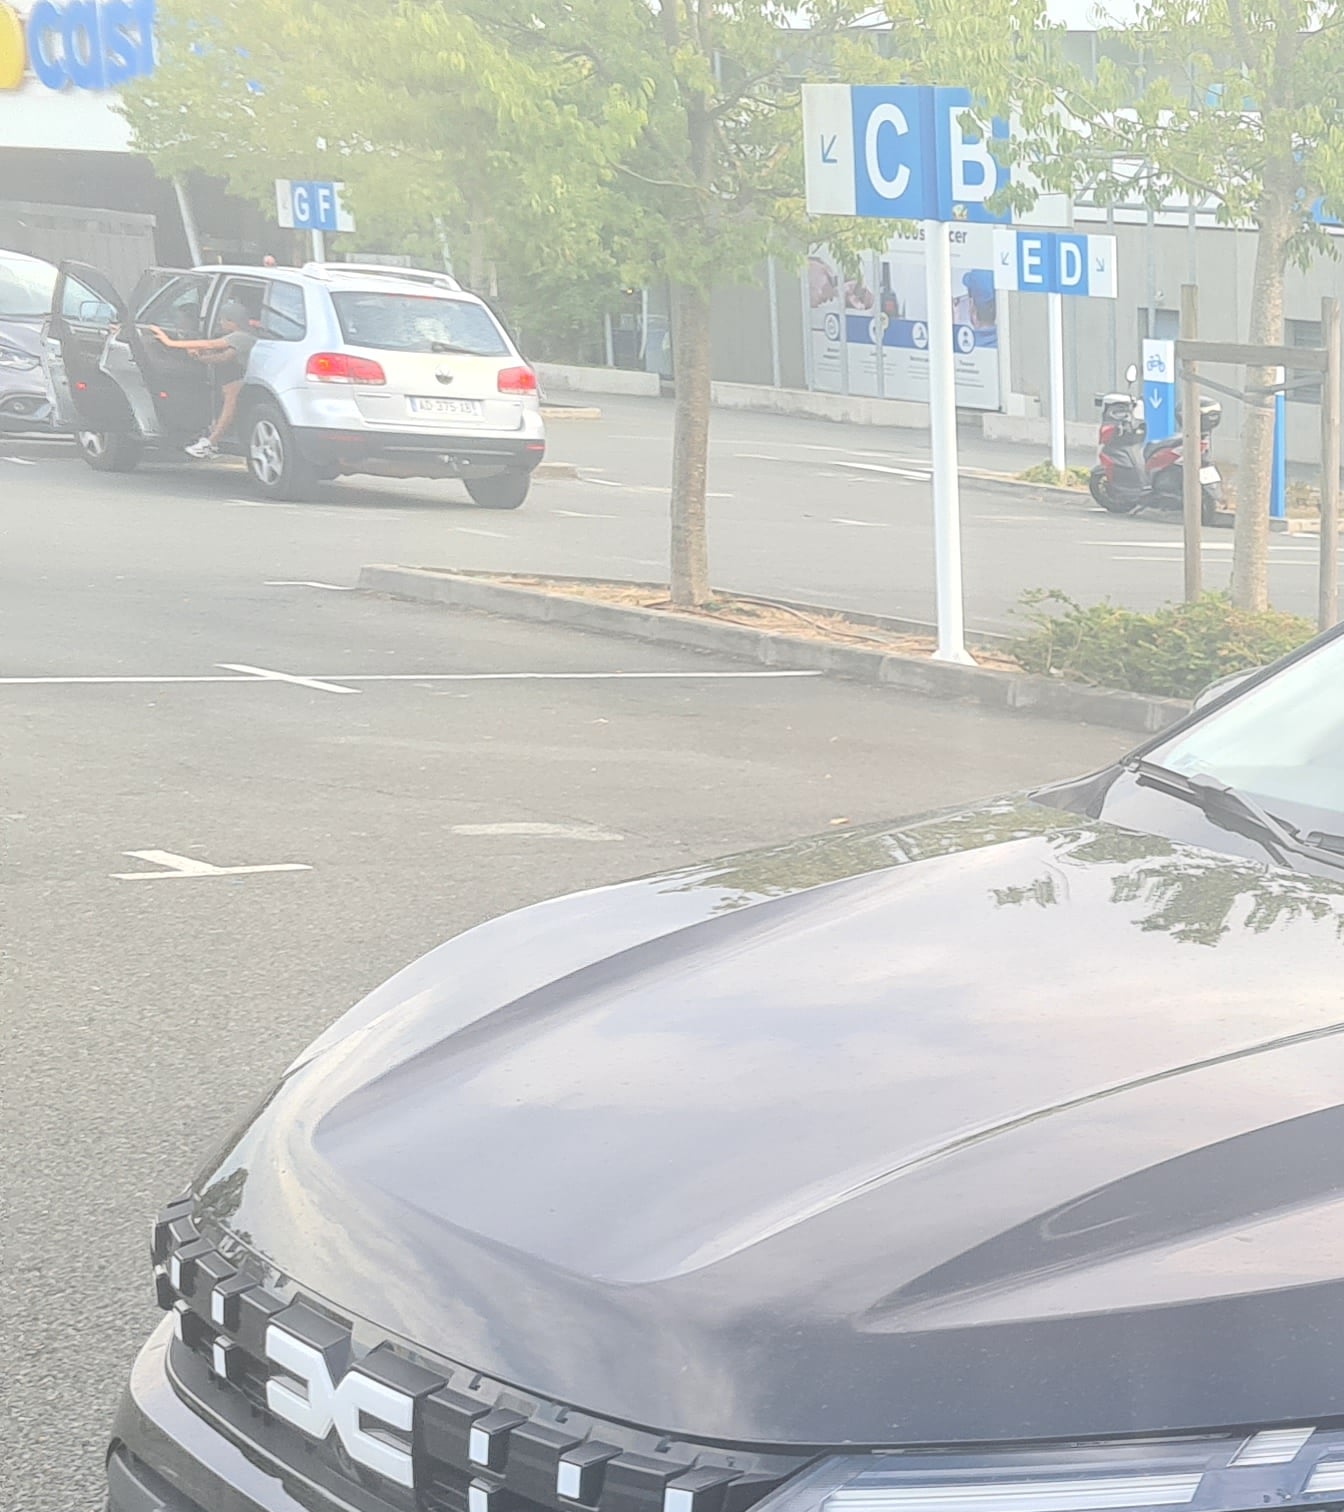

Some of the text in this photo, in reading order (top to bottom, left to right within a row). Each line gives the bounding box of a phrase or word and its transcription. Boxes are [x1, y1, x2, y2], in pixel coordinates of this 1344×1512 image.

[865, 103, 911, 199] C
[949, 106, 998, 202] B
[294, 186, 310, 222] G
[318, 188, 331, 223] F
[1022, 239, 1043, 284] E
[1059, 241, 1082, 286] D
